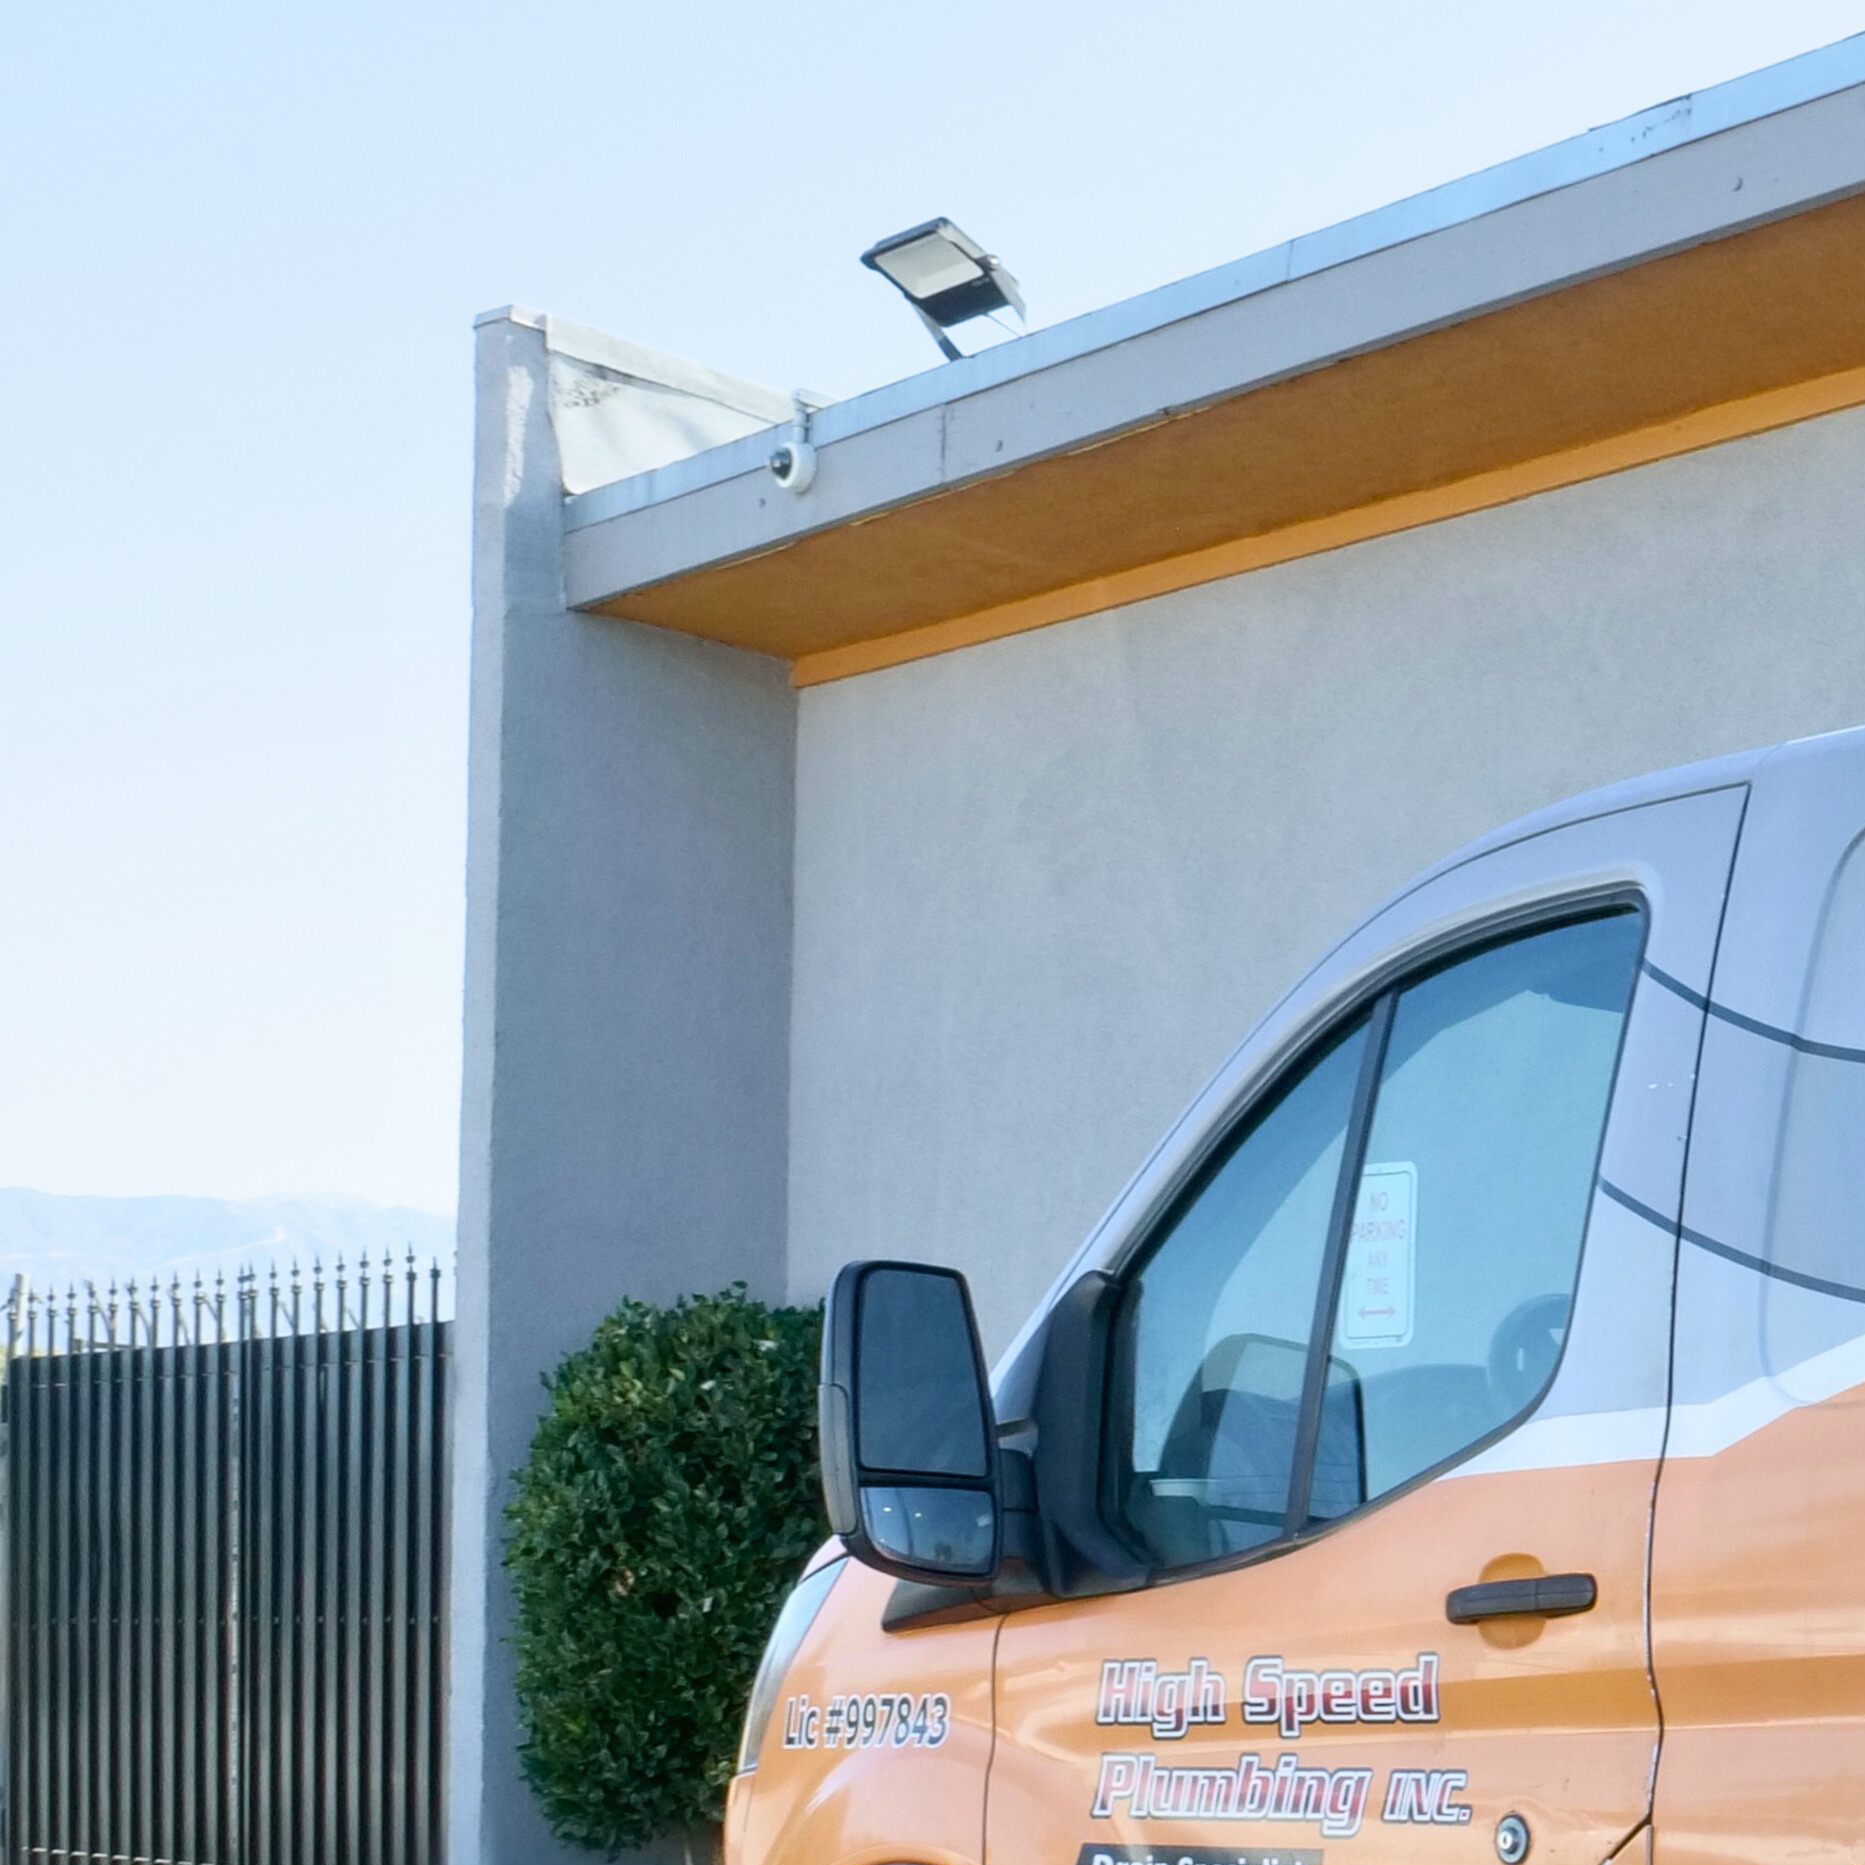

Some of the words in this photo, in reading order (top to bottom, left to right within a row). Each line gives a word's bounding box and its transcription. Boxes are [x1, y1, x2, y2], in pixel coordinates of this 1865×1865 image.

[1369, 1191, 1389, 1213] NO
[784, 1697, 818, 1748] Lic
[824, 1692, 950, 1749] #997843
[1096, 1658, 1225, 1738] High
[1243, 1653, 1440, 1738] Speed
[1091, 1752, 1371, 1838] Plumbing
[1383, 1769, 1472, 1825] INC.
